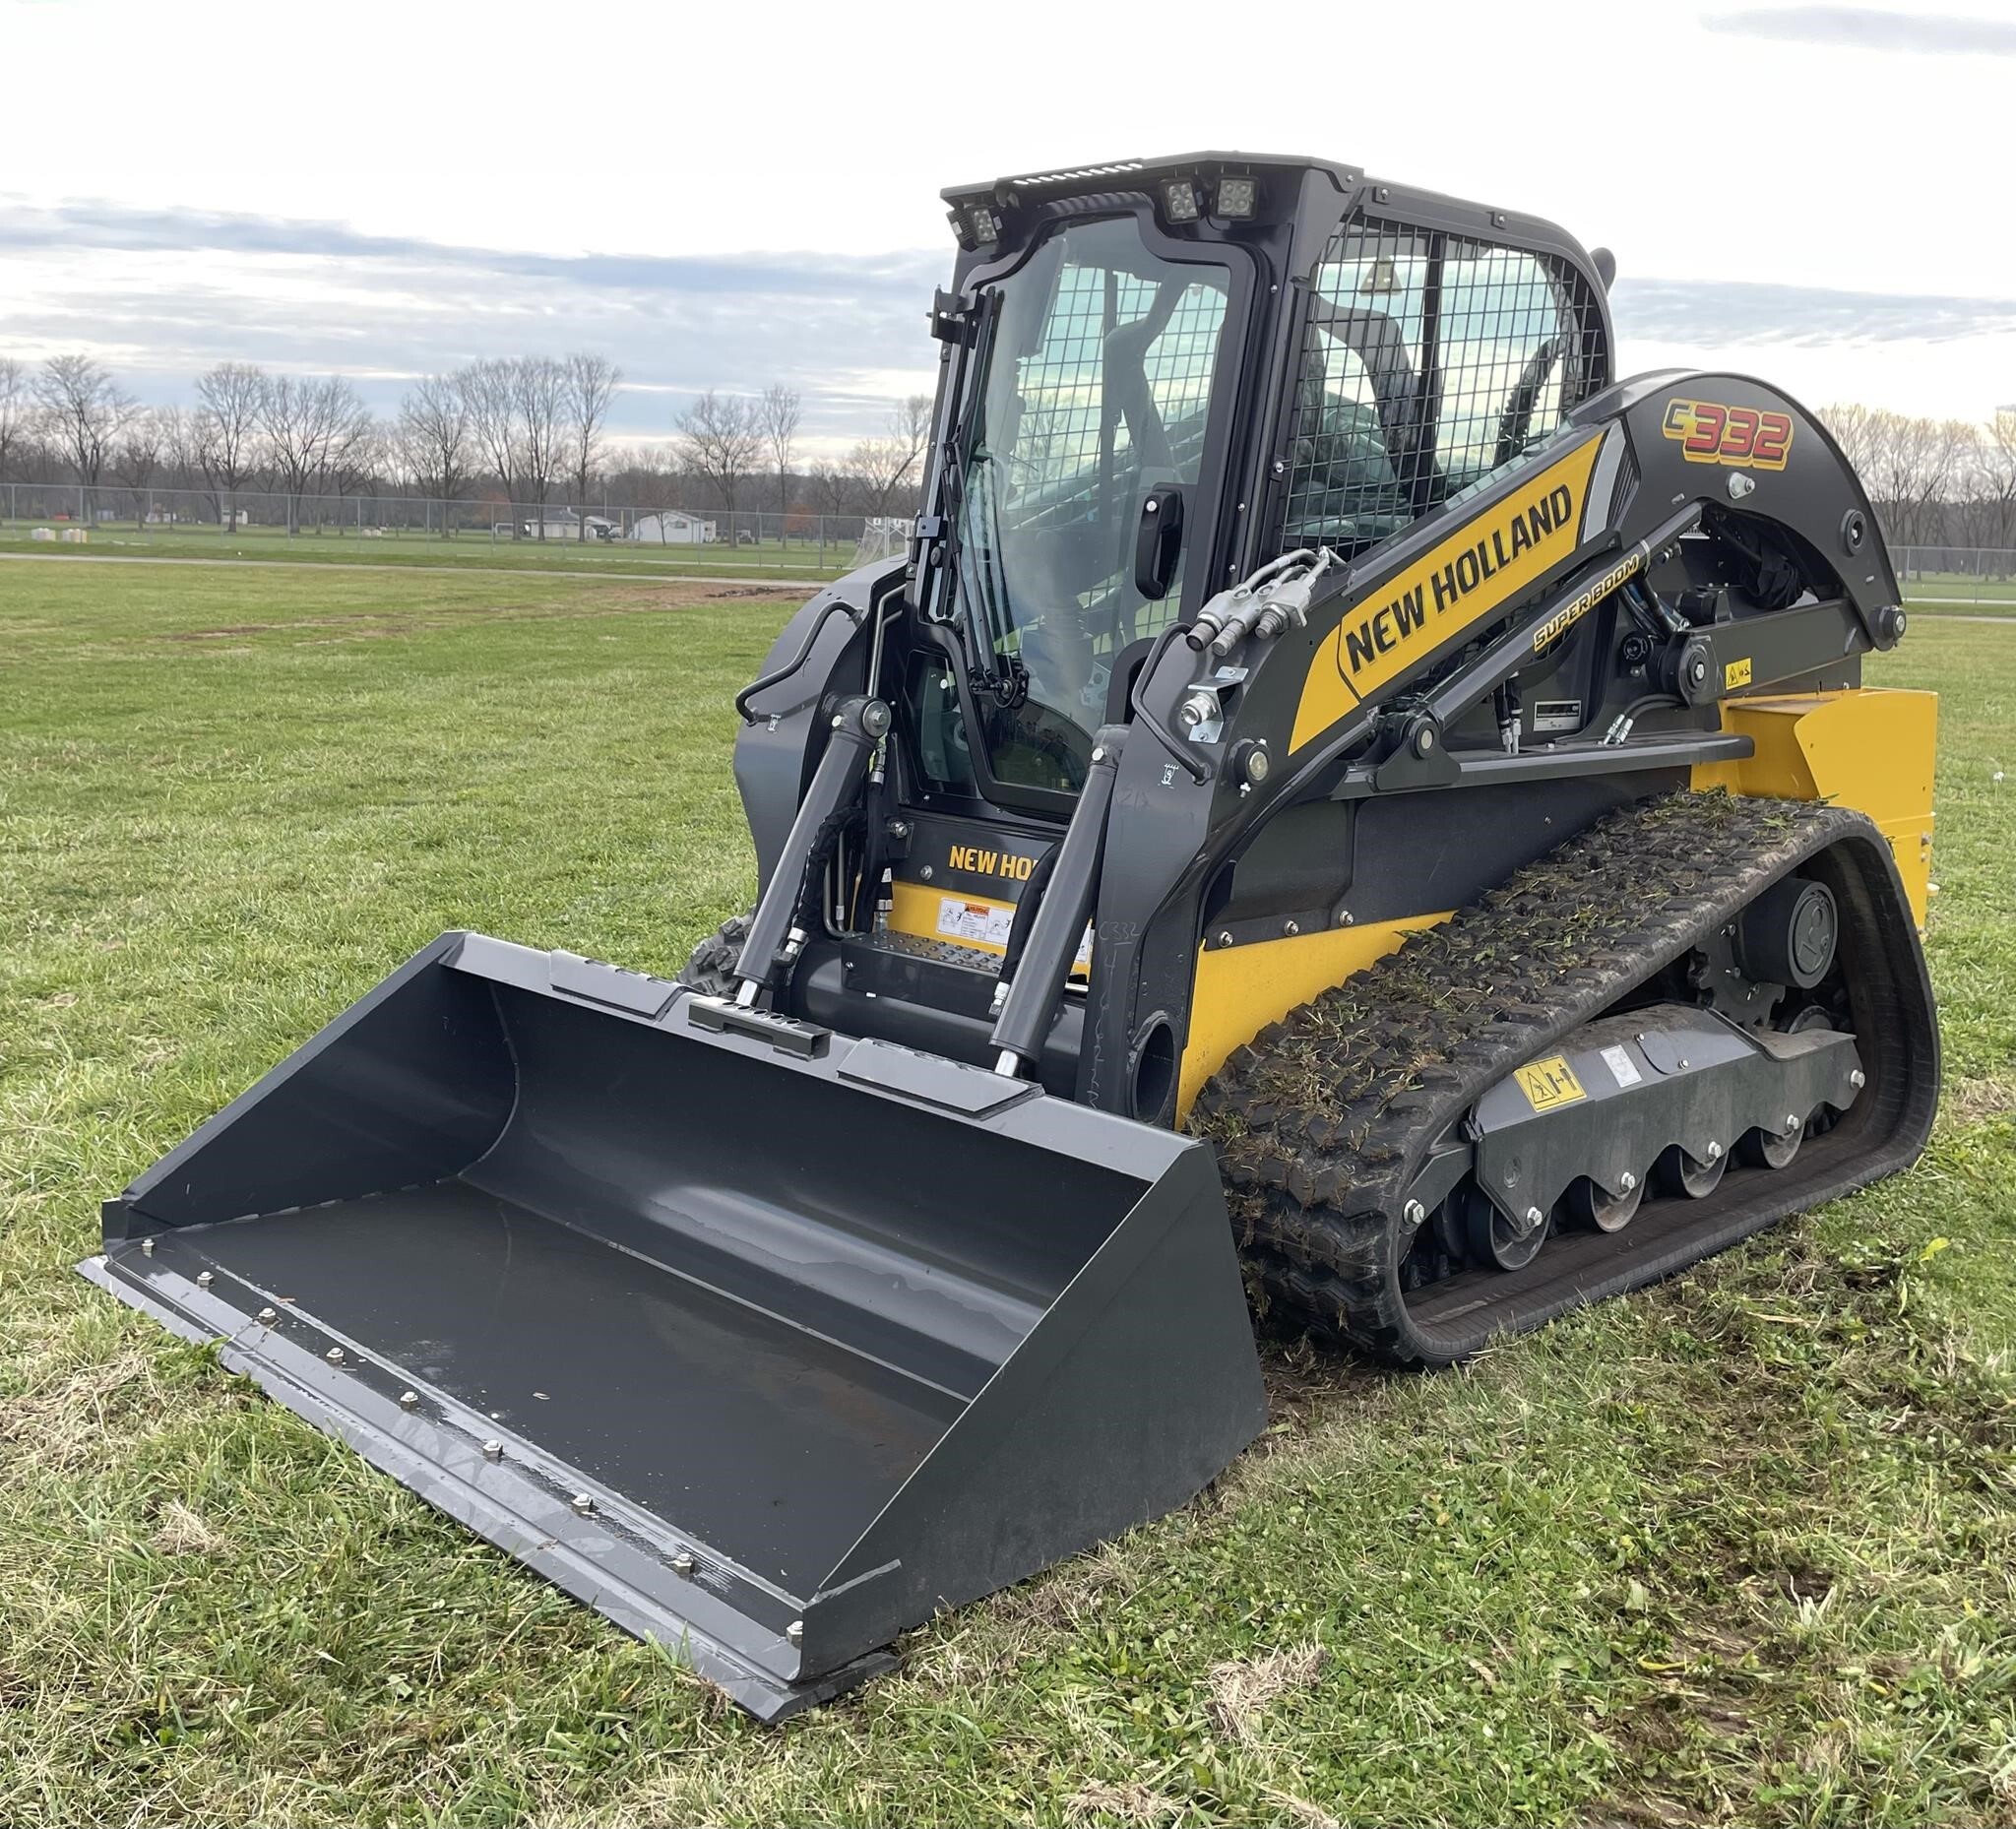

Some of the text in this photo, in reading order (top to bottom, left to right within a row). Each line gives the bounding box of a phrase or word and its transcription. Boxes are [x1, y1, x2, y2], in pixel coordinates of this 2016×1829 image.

[1664, 399, 1795, 471] C332
[1345, 483, 1572, 674] NEW HOLLAND
[1534, 553, 1639, 652] SUPER BOOM
[949, 845, 998, 875] NEW
